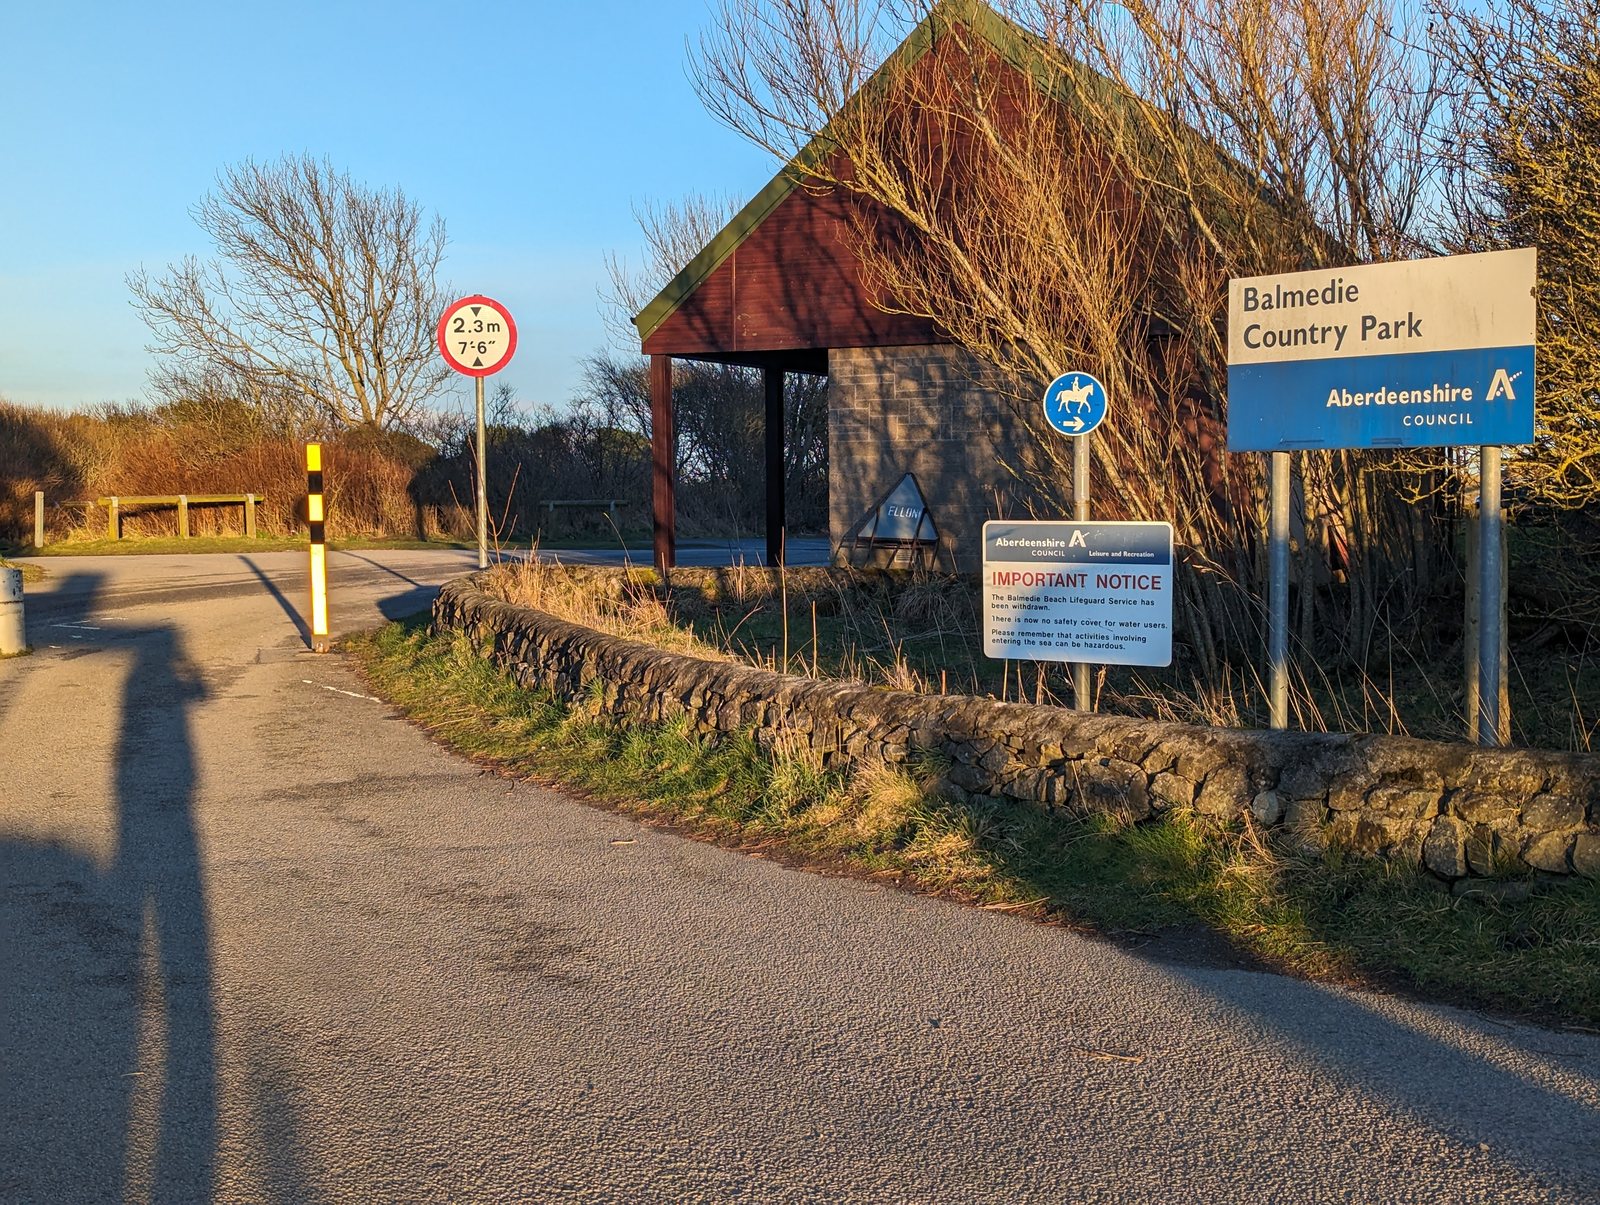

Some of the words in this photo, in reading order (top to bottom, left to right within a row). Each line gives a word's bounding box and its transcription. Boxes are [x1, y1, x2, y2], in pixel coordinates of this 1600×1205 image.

[1243, 278, 1359, 312] Balmedie
[1243, 323, 1348, 351] Country
[1361, 312, 1423, 341] Park
[1326, 383, 1473, 407] Aberdeenshire
[1403, 413, 1473, 426] COUNCIL
[996, 538, 1065, 547] Aberdeenshire
[992, 571, 1087, 588] IMPORTANT
[1096, 574, 1162, 590] NOTICE
[1012, 603, 1050, 611] withdrawn.
[1070, 597, 1105, 605] Lifeguard
[992, 615, 1011, 623] There
[1054, 618, 1077, 626] safety
[1018, 630, 1053, 638] remember
[1113, 634, 1146, 643] involving
[992, 638, 1021, 646] entering
[1084, 641, 1125, 649] hazardous.
